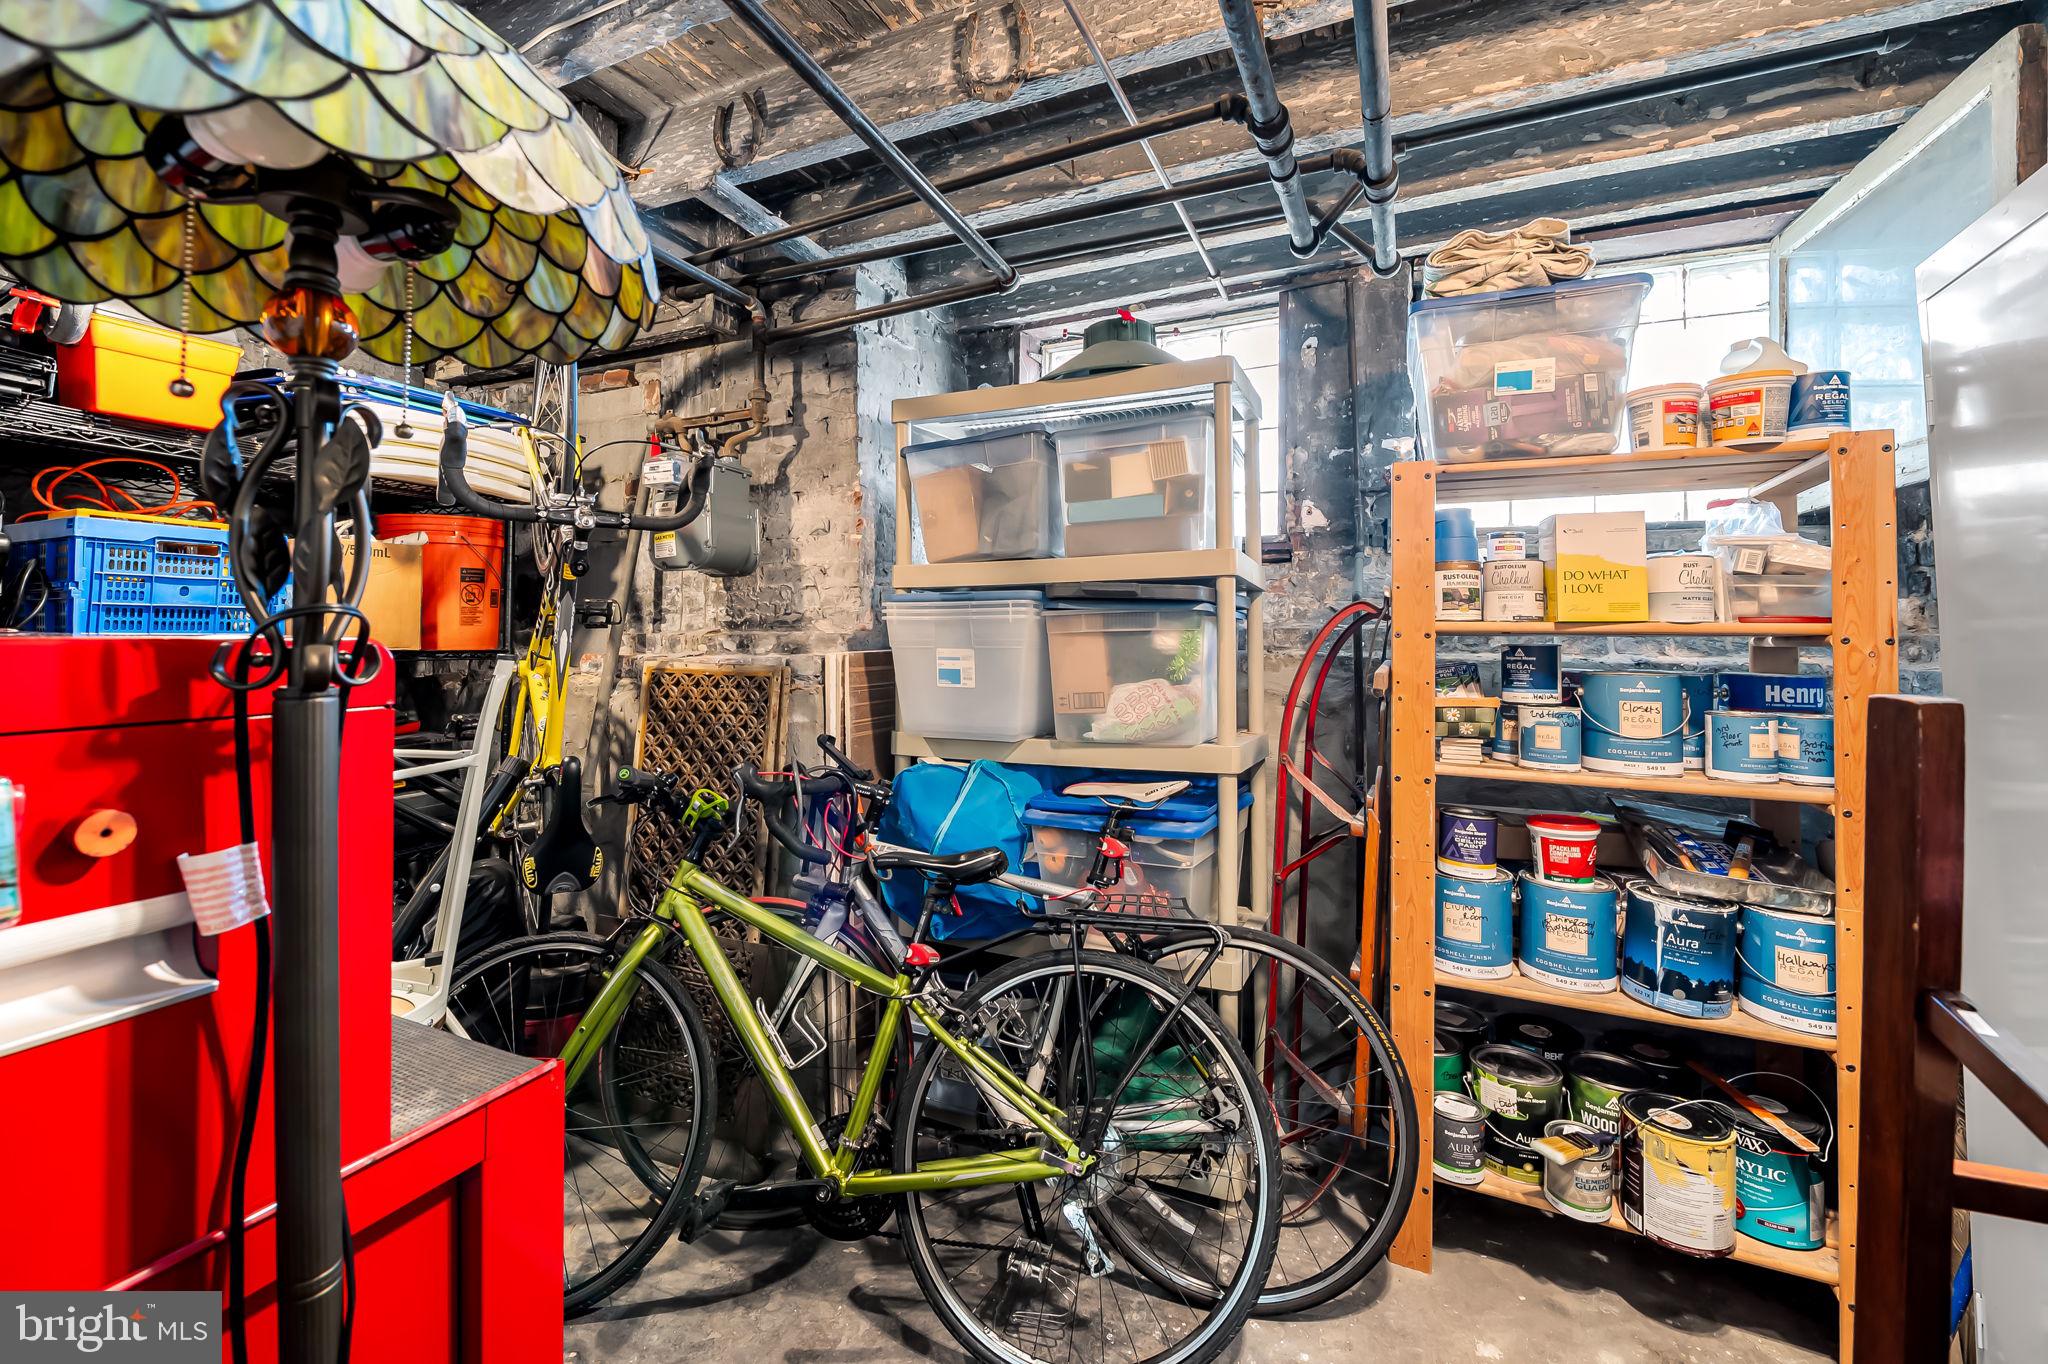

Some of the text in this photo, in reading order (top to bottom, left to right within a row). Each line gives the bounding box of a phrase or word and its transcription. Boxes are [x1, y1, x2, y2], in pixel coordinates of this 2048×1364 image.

[1491, 570, 1531, 586] Chalked
[1563, 570, 1630, 580] DO WHAT
[1678, 569, 1713, 585] Chalke
[1571, 583, 1604, 594] LOVE
[1765, 685, 1824, 708] Henry
[1621, 702, 1661, 714] Closets
[1608, 748, 1647, 756] EGGSHELL
[1454, 837, 1487, 845] CEILING
[1549, 844, 1580, 853] SPACKLING
[1549, 850, 1581, 858] COMPOUND
[1444, 889, 1465, 897] Benjamin
[1444, 901, 1476, 914] Living
[1546, 899, 1570, 908] Benjamin
[1446, 917, 1477, 928] REGAL
[1665, 933, 1699, 949] Aura
[1775, 930, 1826, 944] Benjamin Moore
[1535, 957, 1599, 974] EGGSHELL FINISH
[1777, 951, 1836, 975] Hallways
[1779, 965, 1824, 977] REGAL
[1555, 977, 1568, 985] 549
[1762, 994, 1836, 1015] EGGSHELL FINIS
[1350, 993, 1398, 1061] GATORSKIN
[1780, 1014, 1795, 1022] BASE
[1808, 1022, 1823, 1030] 549
[1585, 1101, 1619, 1118] Benjamin
[1580, 1109, 1620, 1136] WOOD
[1444, 1129, 1466, 1138] Benjamin
[1447, 1141, 1478, 1153] AURA
[1736, 1156, 1786, 1183] RYLIC
[1575, 1176, 1610, 1185] ELEMENT
[1575, 1182, 1610, 1191] GUARD
